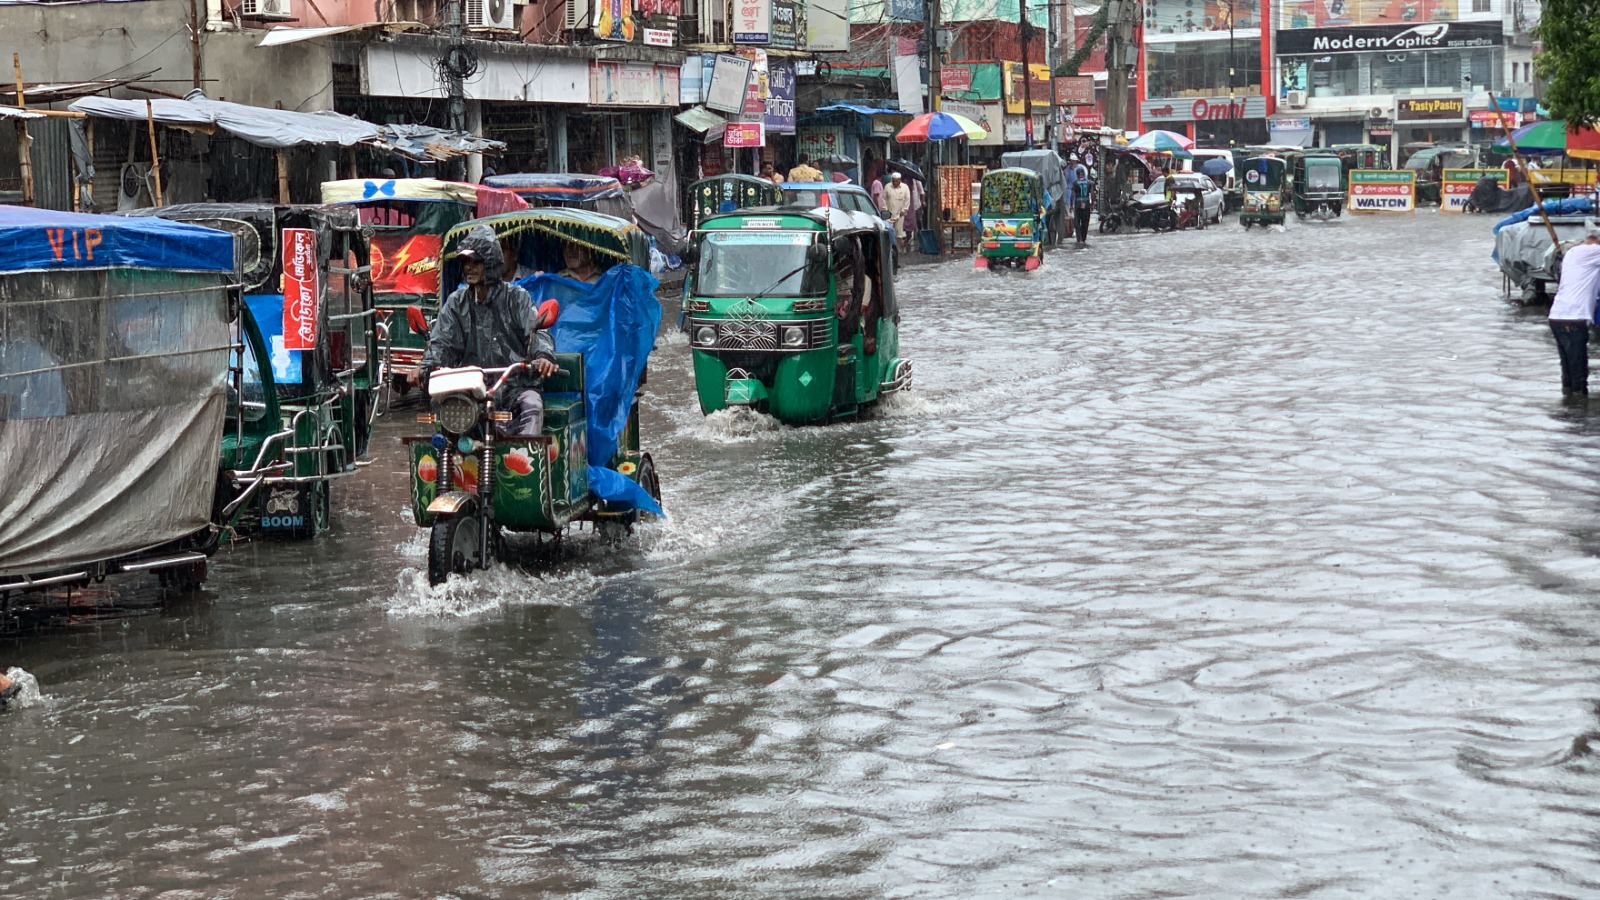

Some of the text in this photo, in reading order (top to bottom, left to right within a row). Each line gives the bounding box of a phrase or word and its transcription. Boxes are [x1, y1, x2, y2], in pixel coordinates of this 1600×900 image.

[1313, 34, 1439, 49] Modern optics
[1192, 98, 1247, 120] Omni
[1409, 100, 1462, 113] Tasty Pastry
[1357, 198, 1407, 207] WALTON
[46, 228, 102, 261] VIP
[292, 232, 305, 277] মেডিকেল
[261, 516, 303, 527] BOOM
